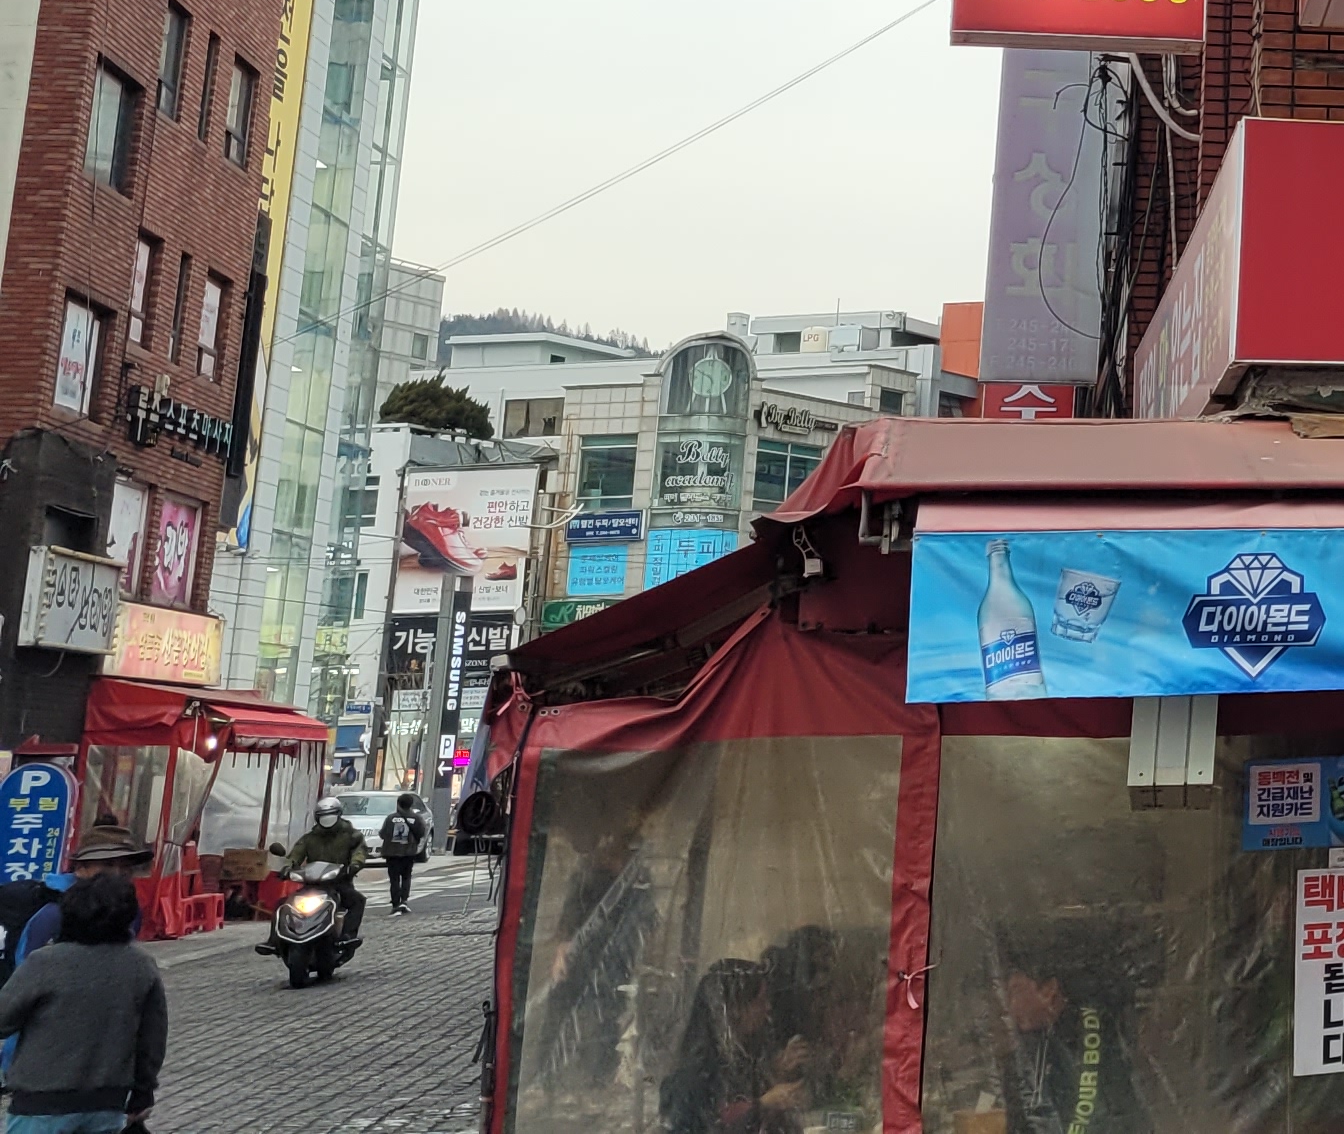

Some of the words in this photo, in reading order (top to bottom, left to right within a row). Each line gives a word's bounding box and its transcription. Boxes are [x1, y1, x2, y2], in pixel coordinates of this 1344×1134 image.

[487, 501, 530, 514] 편안하고
[473, 516, 505, 529] 건강한
[1199, 604, 1310, 635] 다이아몬드
[392, 628, 437, 654] 기능
[467, 625, 511, 652] 신발
[1210, 633, 1298, 644] DIAMOND
[446, 611, 467, 711] SAMSUNG
[985, 641, 1036, 670] 다이아몬드
[443, 737, 451, 751] P
[20, 770, 51, 795] P
[1257, 769, 1300, 785] 동백전
[1256, 785, 1314, 802] 긴급재난
[1256, 801, 1314, 819] 지원카드
